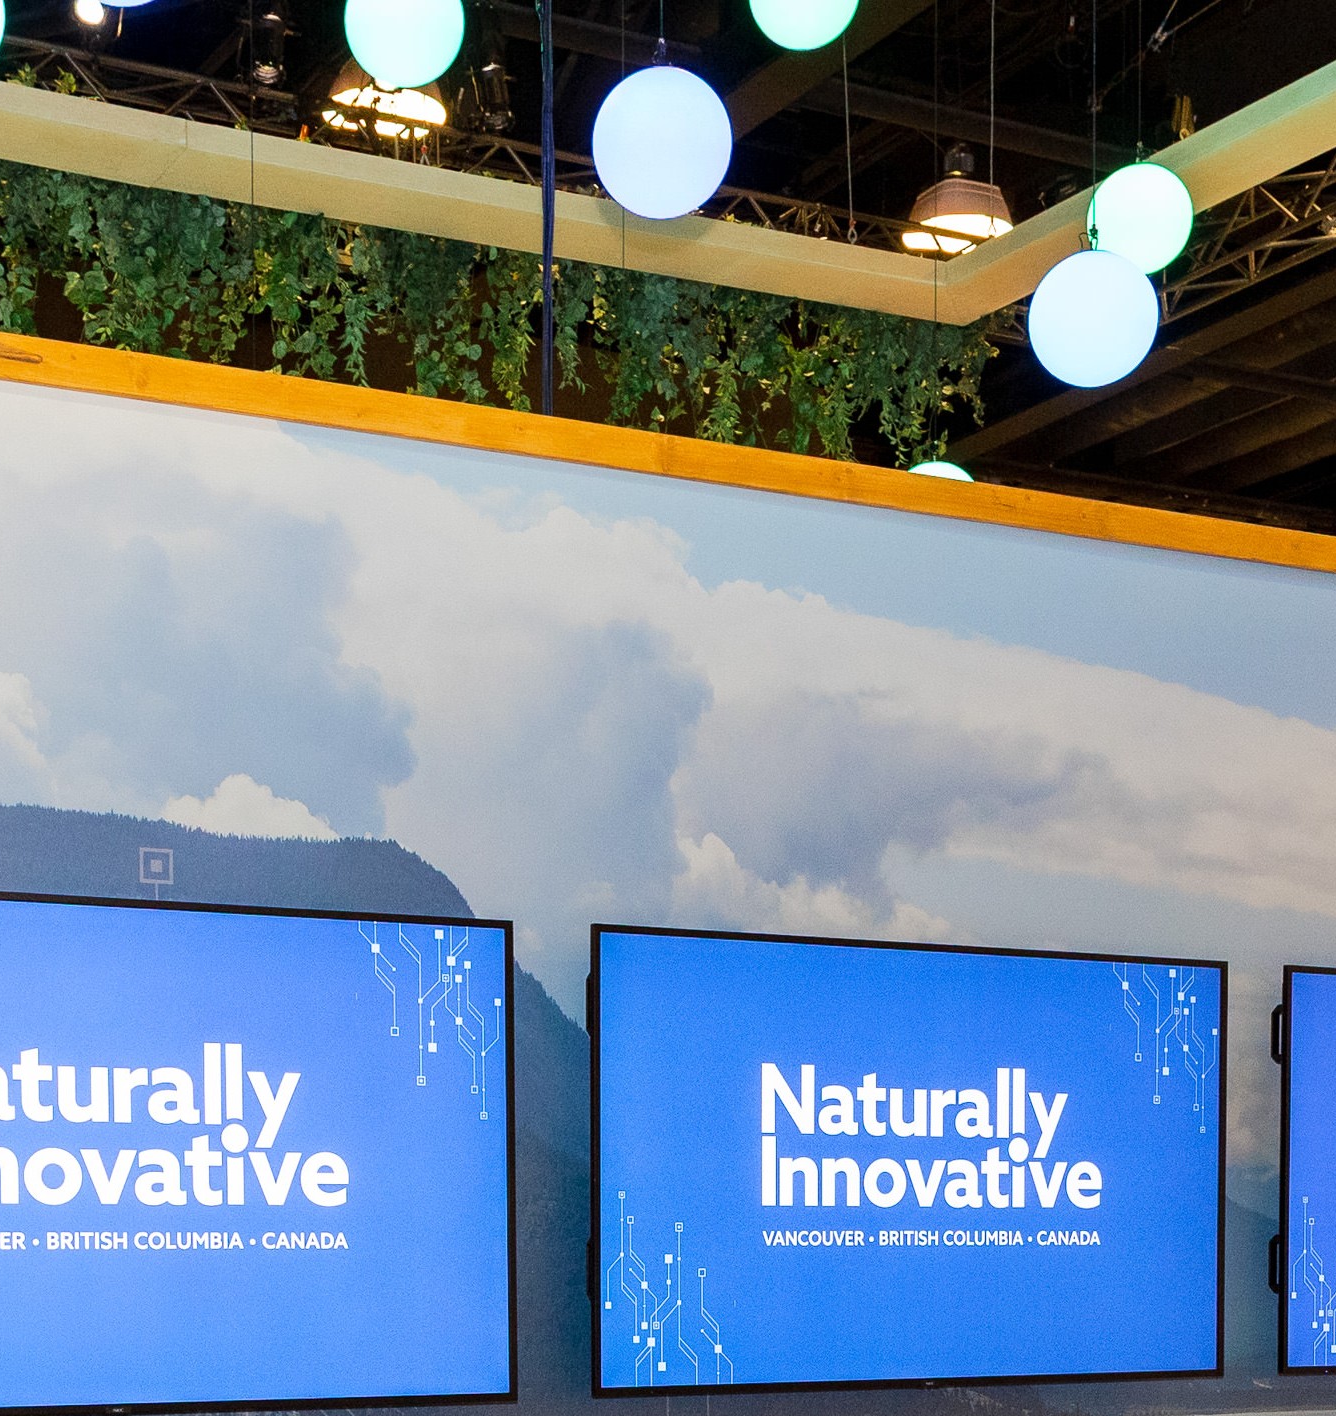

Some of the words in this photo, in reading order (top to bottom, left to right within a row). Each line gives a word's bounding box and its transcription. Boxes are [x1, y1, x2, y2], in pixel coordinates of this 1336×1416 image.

[761, 1062, 1069, 1159] Naturally
[761, 1136, 1103, 1209] Innovative
[46, 1231, 128, 1250] BRITISH
[133, 1231, 245, 1250] COLUMBIA
[261, 1231, 349, 1250] CANADA
[762, 1230, 865, 1246] VANCOUVER
[879, 1230, 939, 1246] BRITISH
[942, 1230, 1024, 1246] COLUMBIA
[1036, 1230, 1101, 1246] CANADA
